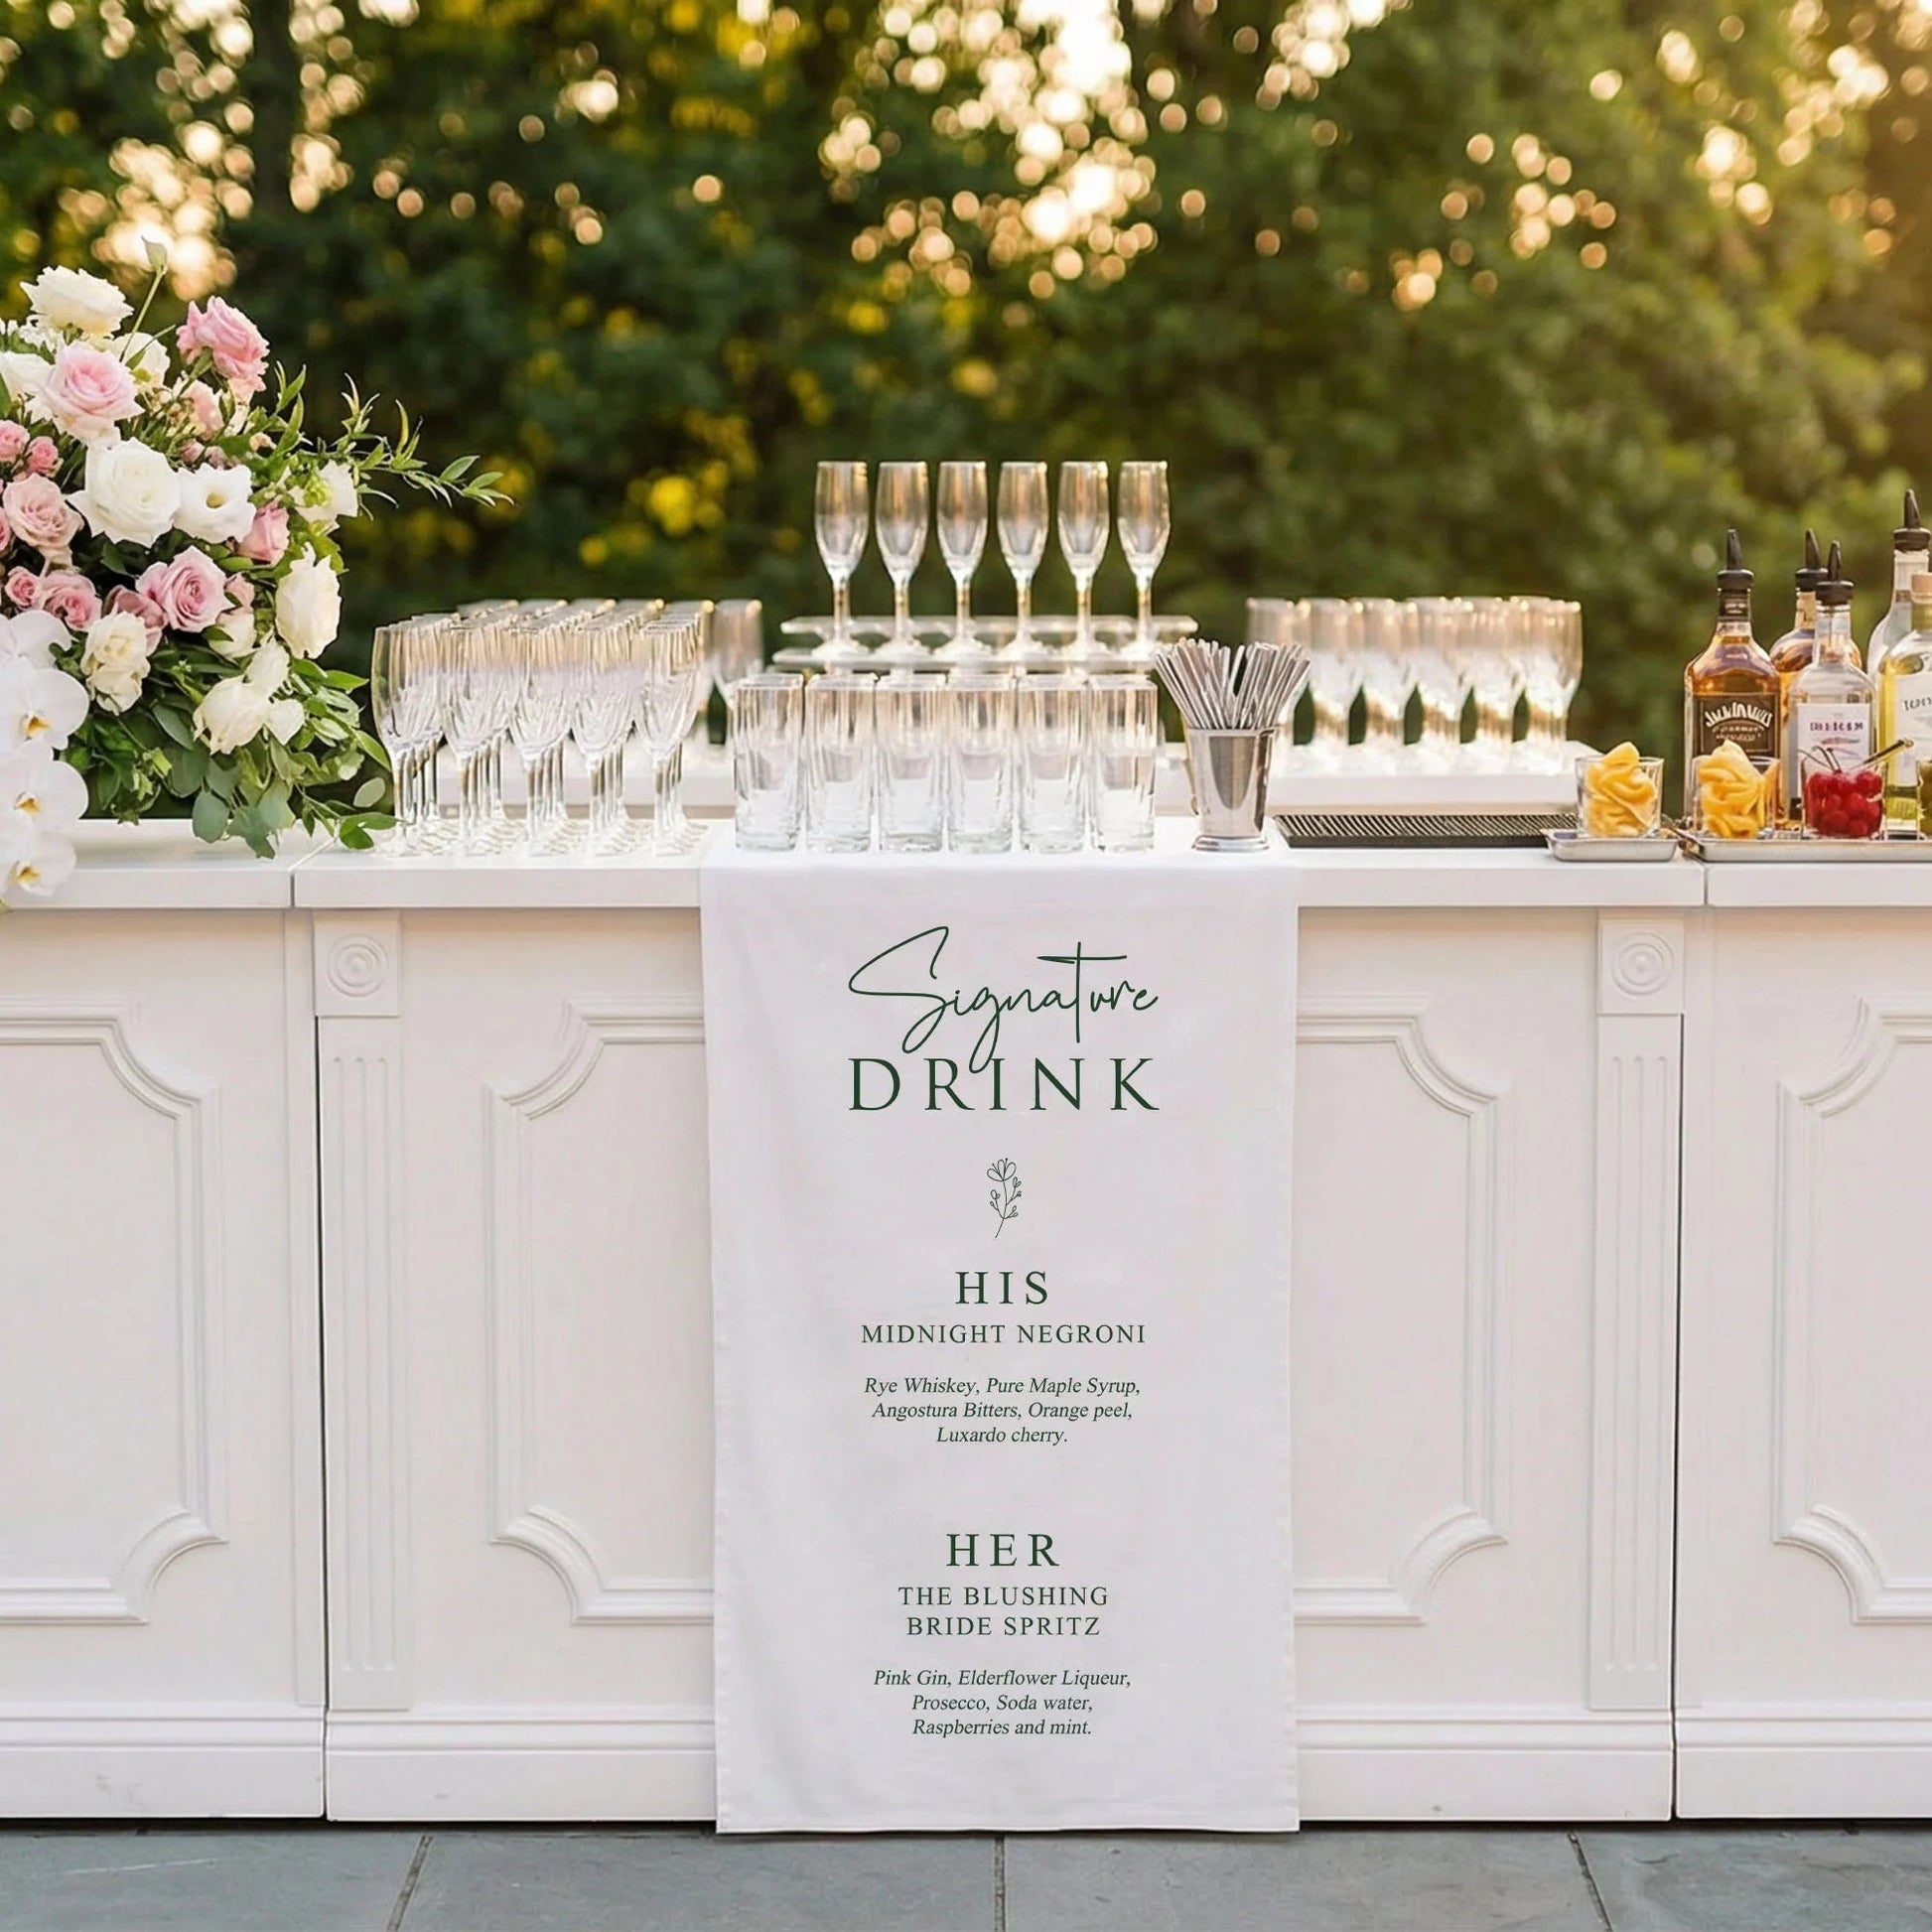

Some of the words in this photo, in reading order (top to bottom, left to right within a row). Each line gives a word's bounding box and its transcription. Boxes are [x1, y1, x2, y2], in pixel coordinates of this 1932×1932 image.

[848, 925, 1160, 1074] Signature
[848, 1056, 1161, 1112] DRINK
[954, 1270, 1048, 1306] HIS
[861, 1323, 1006, 1344] MIDNIGHT
[1016, 1323, 1146, 1344] NEGRONI
[864, 1377, 898, 1398] Rye
[903, 1376, 980, 1398] Whiskey,
[985, 1377, 1025, 1394] Pure
[1028, 1376, 1082, 1398] Maple
[1086, 1377, 1141, 1398] Syrup,
[871, 1402, 958, 1423] Angostura
[962, 1401, 1023, 1421] Bitters,
[1028, 1401, 1089, 1423] Orange
[1092, 1402, 1133, 1423] peel,
[936, 1426, 1007, 1444] Luxardo
[1011, 1426, 1068, 1447] cherry.
[945, 1533, 1060, 1567] HER
[897, 1586, 953, 1606] THE
[963, 1586, 1108, 1606] BLUSHING
[906, 1616, 993, 1636] BRIDE
[1004, 1616, 1100, 1636] SPRITZ
[873, 1669, 912, 1686] Pink
[916, 1669, 952, 1689] Gin,
[957, 1669, 1058, 1686] Elderflower
[1060, 1669, 1131, 1690] Liqueur,
[911, 1694, 991, 1714] Prosecco,
[996, 1694, 1037, 1711] Soda
[1042, 1696, 1093, 1714] water,
[911, 1719, 1011, 1739] Raspberries
[1014, 1719, 1046, 1735] and
[1048, 1719, 1092, 1735] mint.
